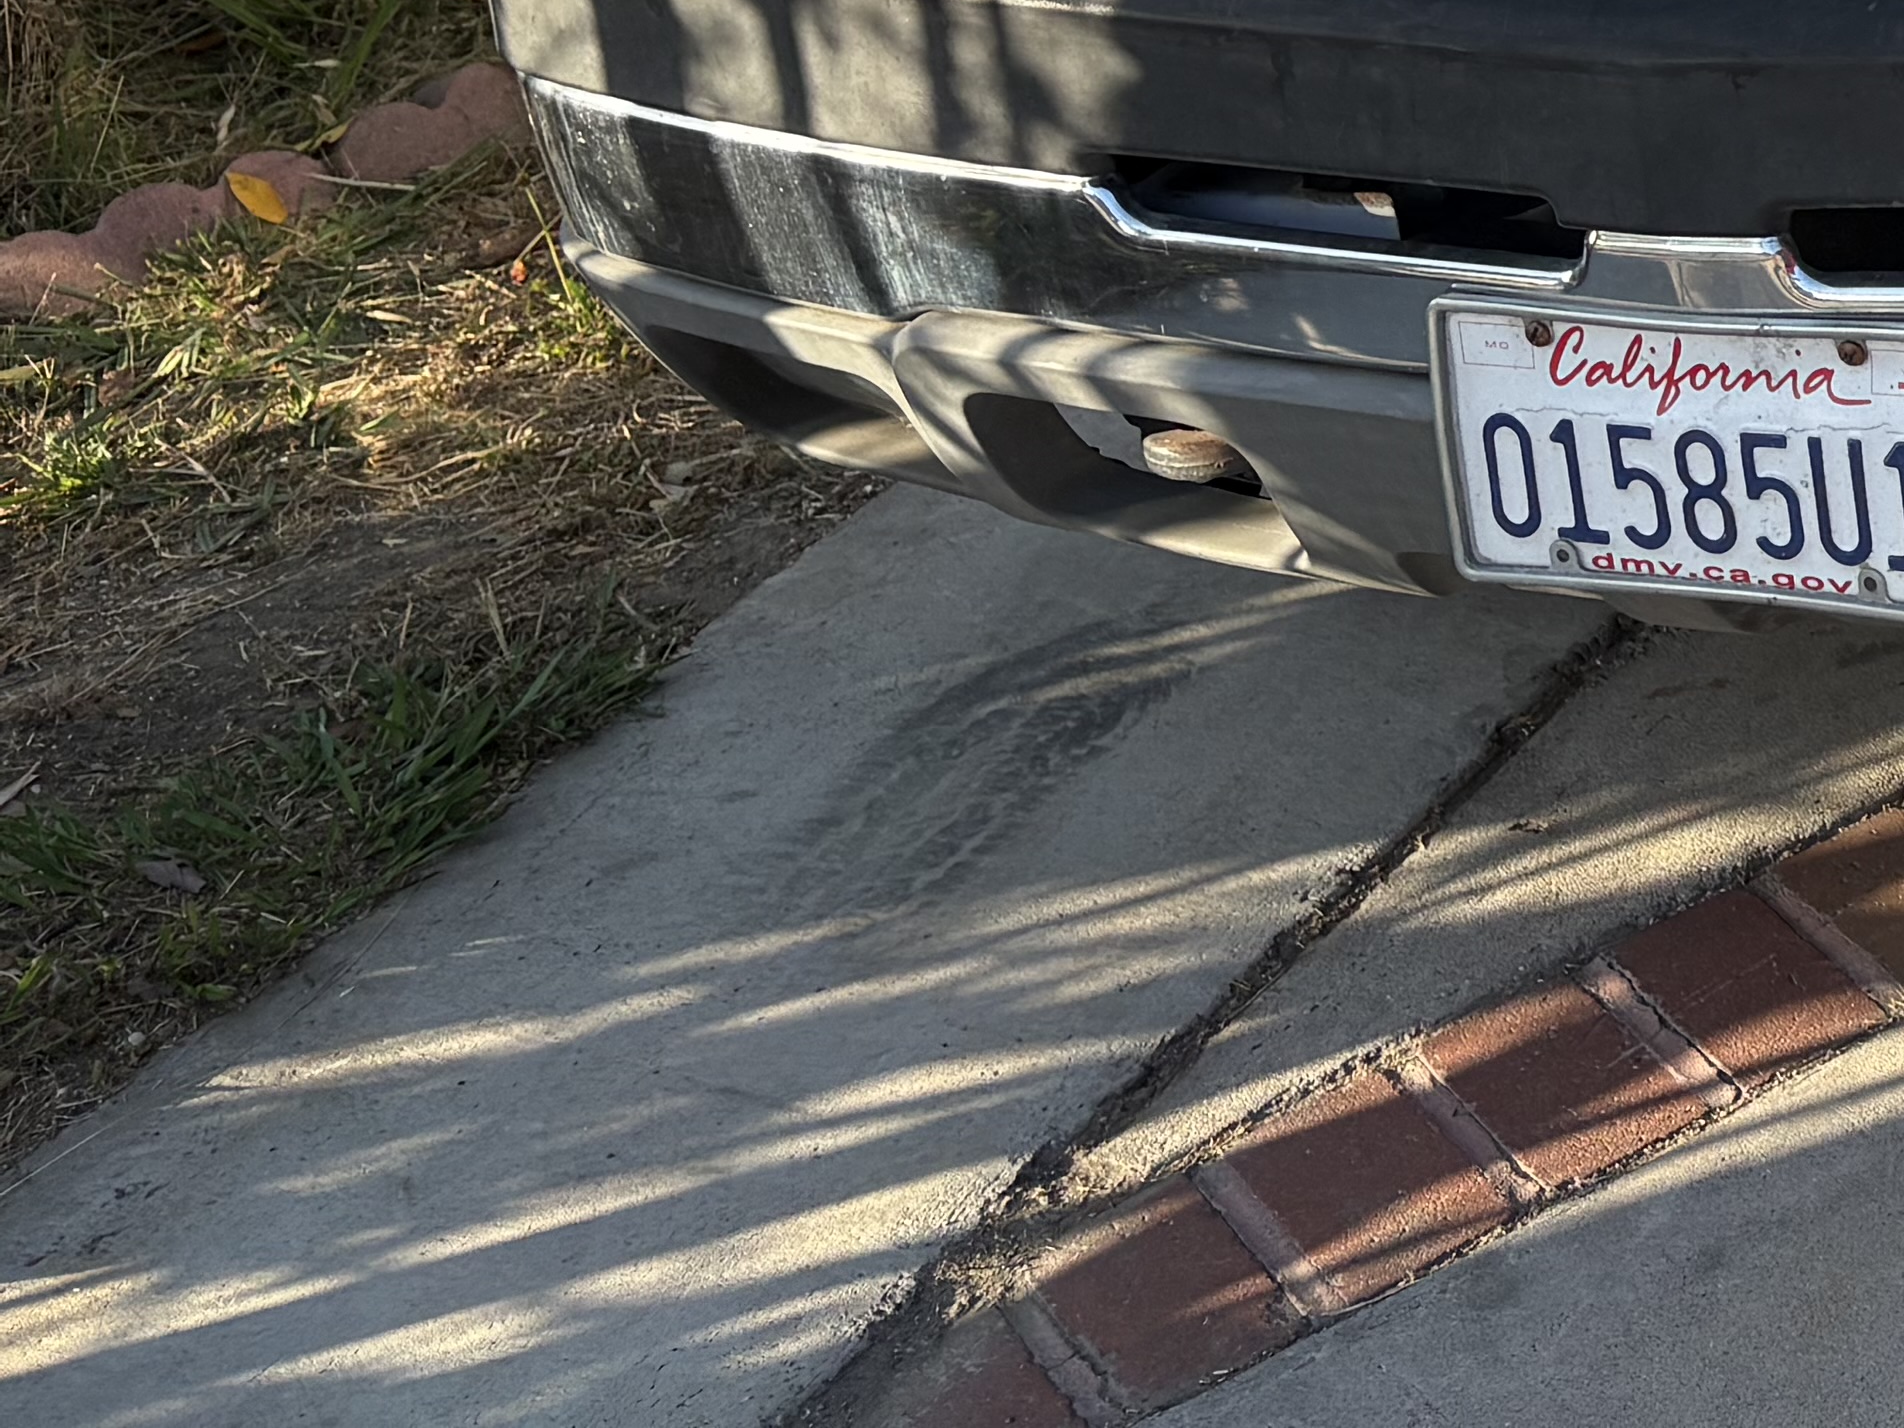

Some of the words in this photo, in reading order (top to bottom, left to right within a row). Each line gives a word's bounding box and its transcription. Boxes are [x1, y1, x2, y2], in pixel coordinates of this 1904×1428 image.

[1484, 340, 1510, 350] MO
[1549, 326, 1872, 416] California
[1591, 551, 1853, 595] dmv.ca.gov
